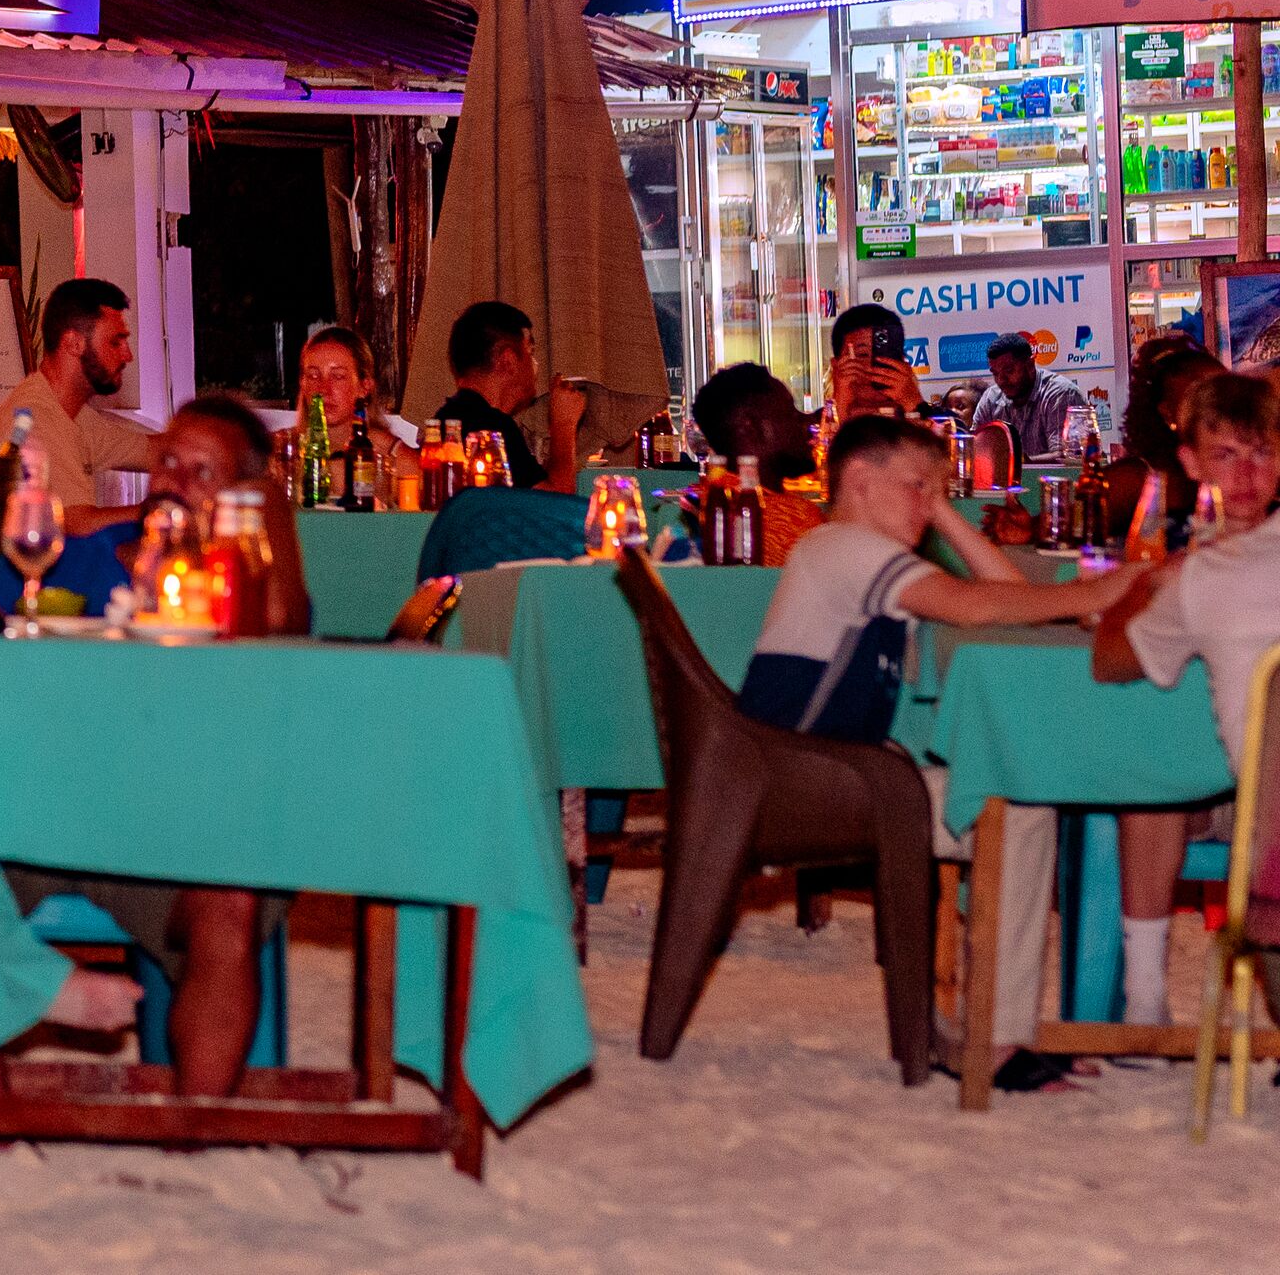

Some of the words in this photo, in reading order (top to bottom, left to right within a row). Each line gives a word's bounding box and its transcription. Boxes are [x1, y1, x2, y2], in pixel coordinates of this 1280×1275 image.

[895, 283, 978, 316] CASH
[987, 275, 1085, 309] POINT
[1067, 351, 1101, 363] PayPal
